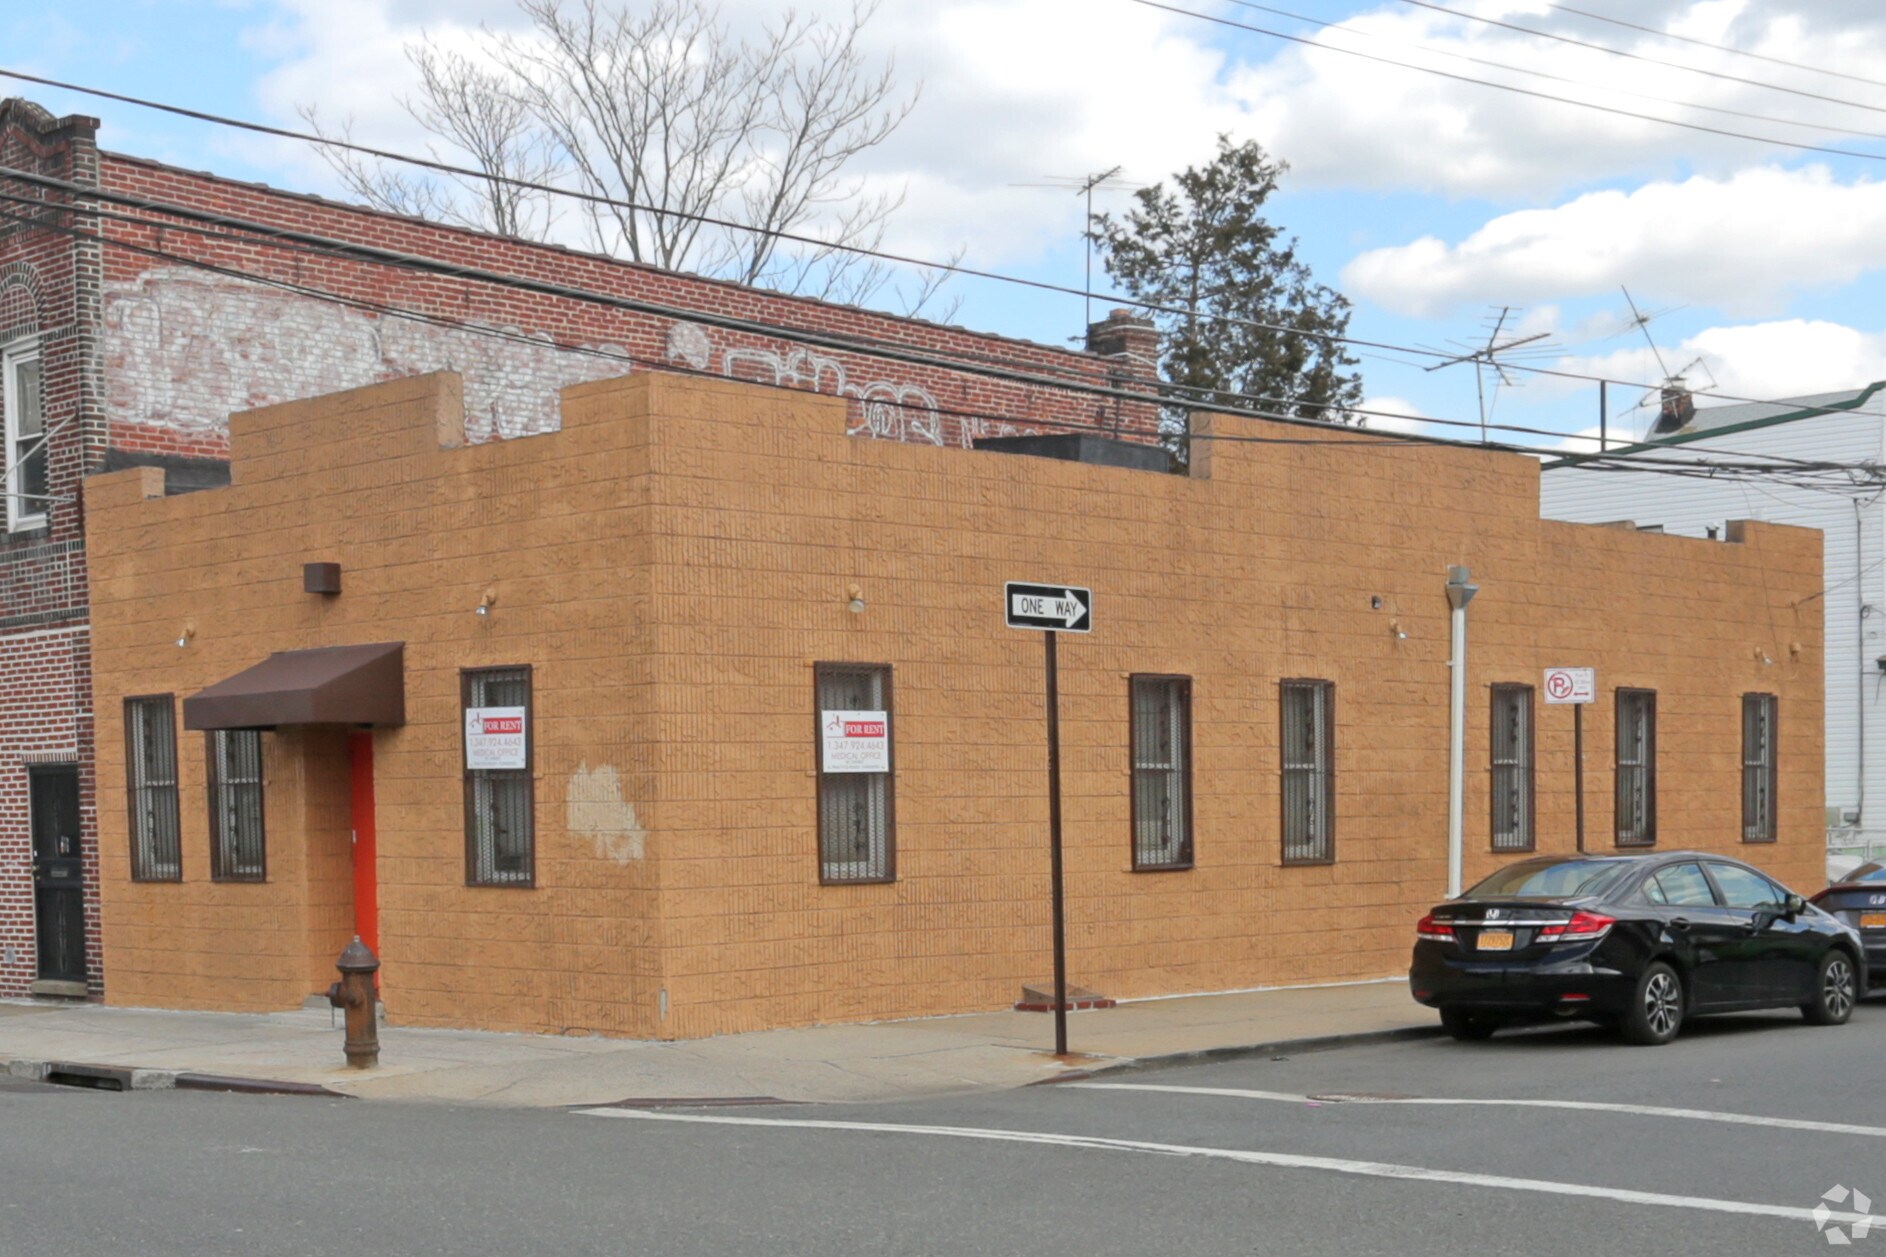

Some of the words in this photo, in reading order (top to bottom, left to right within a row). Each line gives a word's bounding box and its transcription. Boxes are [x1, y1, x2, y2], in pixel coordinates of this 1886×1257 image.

[1021, 597, 1044, 615] ONE
[1055, 600, 1078, 617] WAY
[484, 720, 499, 731] FOR
[500, 720, 521, 731] RENT
[846, 724, 862, 734] FOR
[863, 724, 884, 734] RENT
